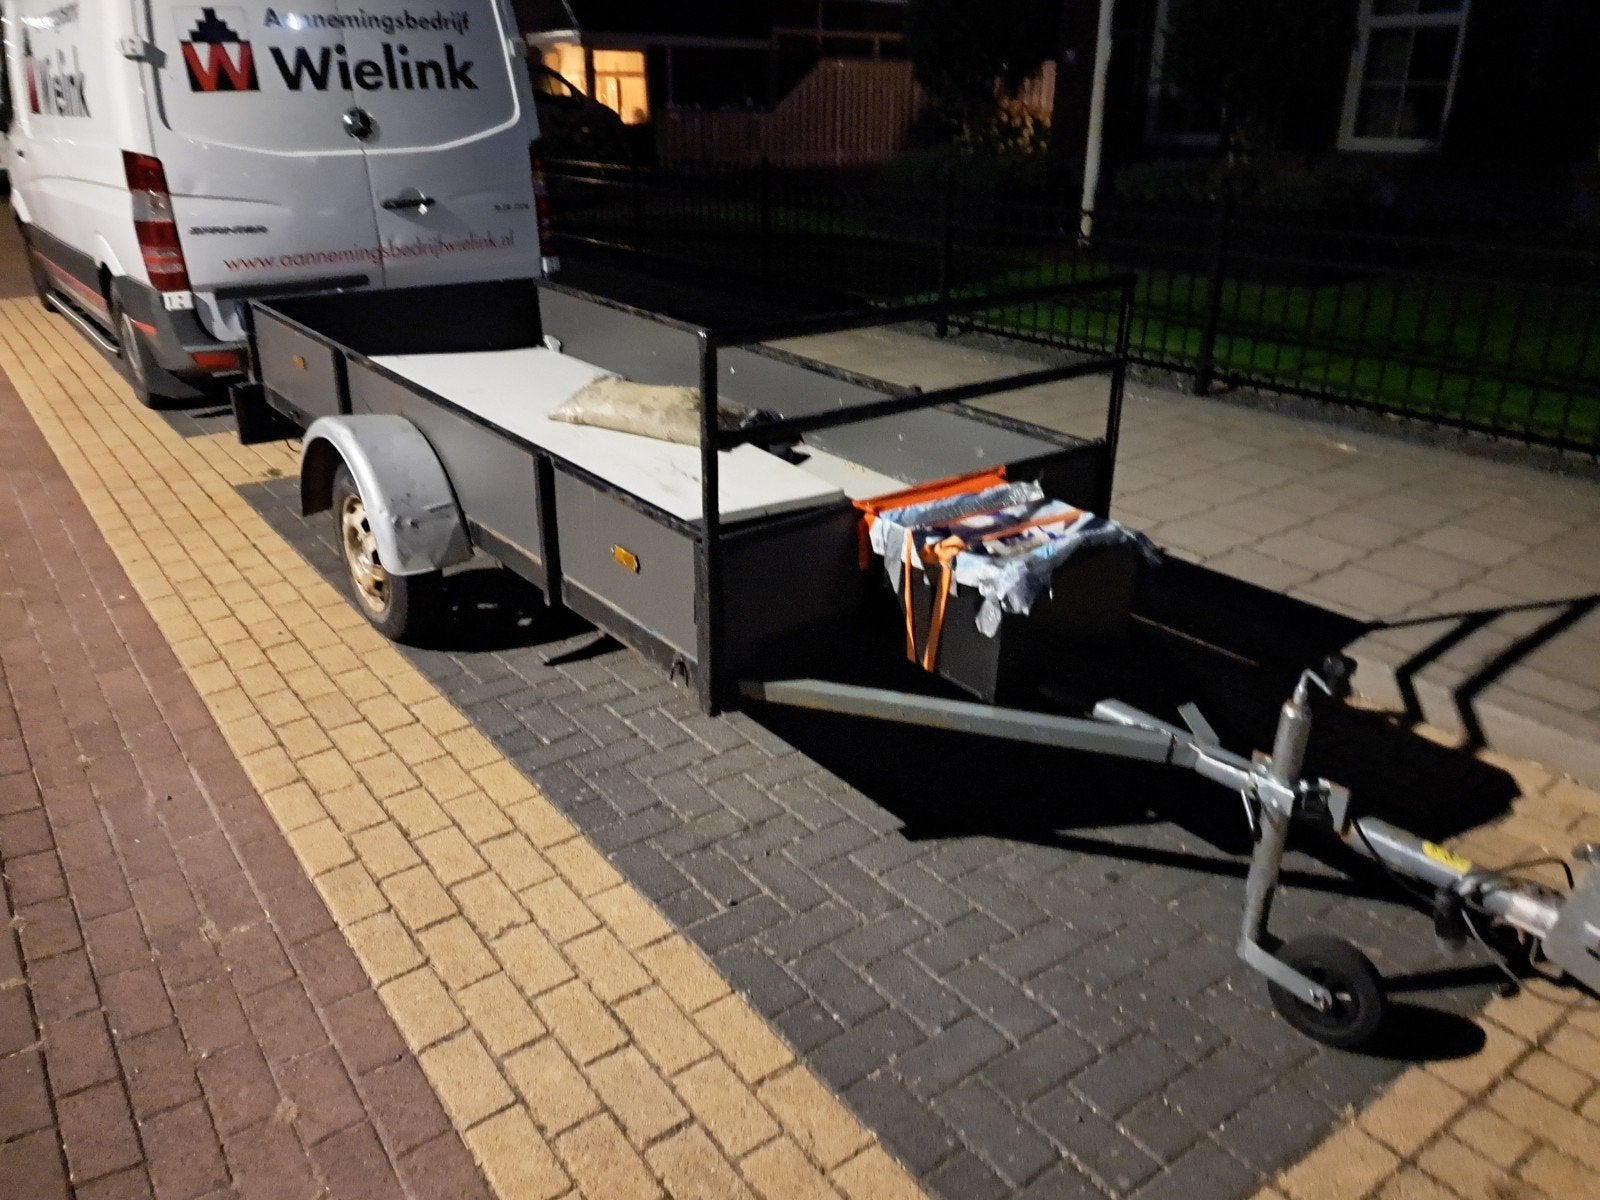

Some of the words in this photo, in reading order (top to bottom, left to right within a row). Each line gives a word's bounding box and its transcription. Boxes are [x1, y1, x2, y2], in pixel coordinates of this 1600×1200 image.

[264, 7, 470, 35] Annemingsbedrijf
[180, 41, 258, 92] W
[268, 42, 479, 91] Wielink
